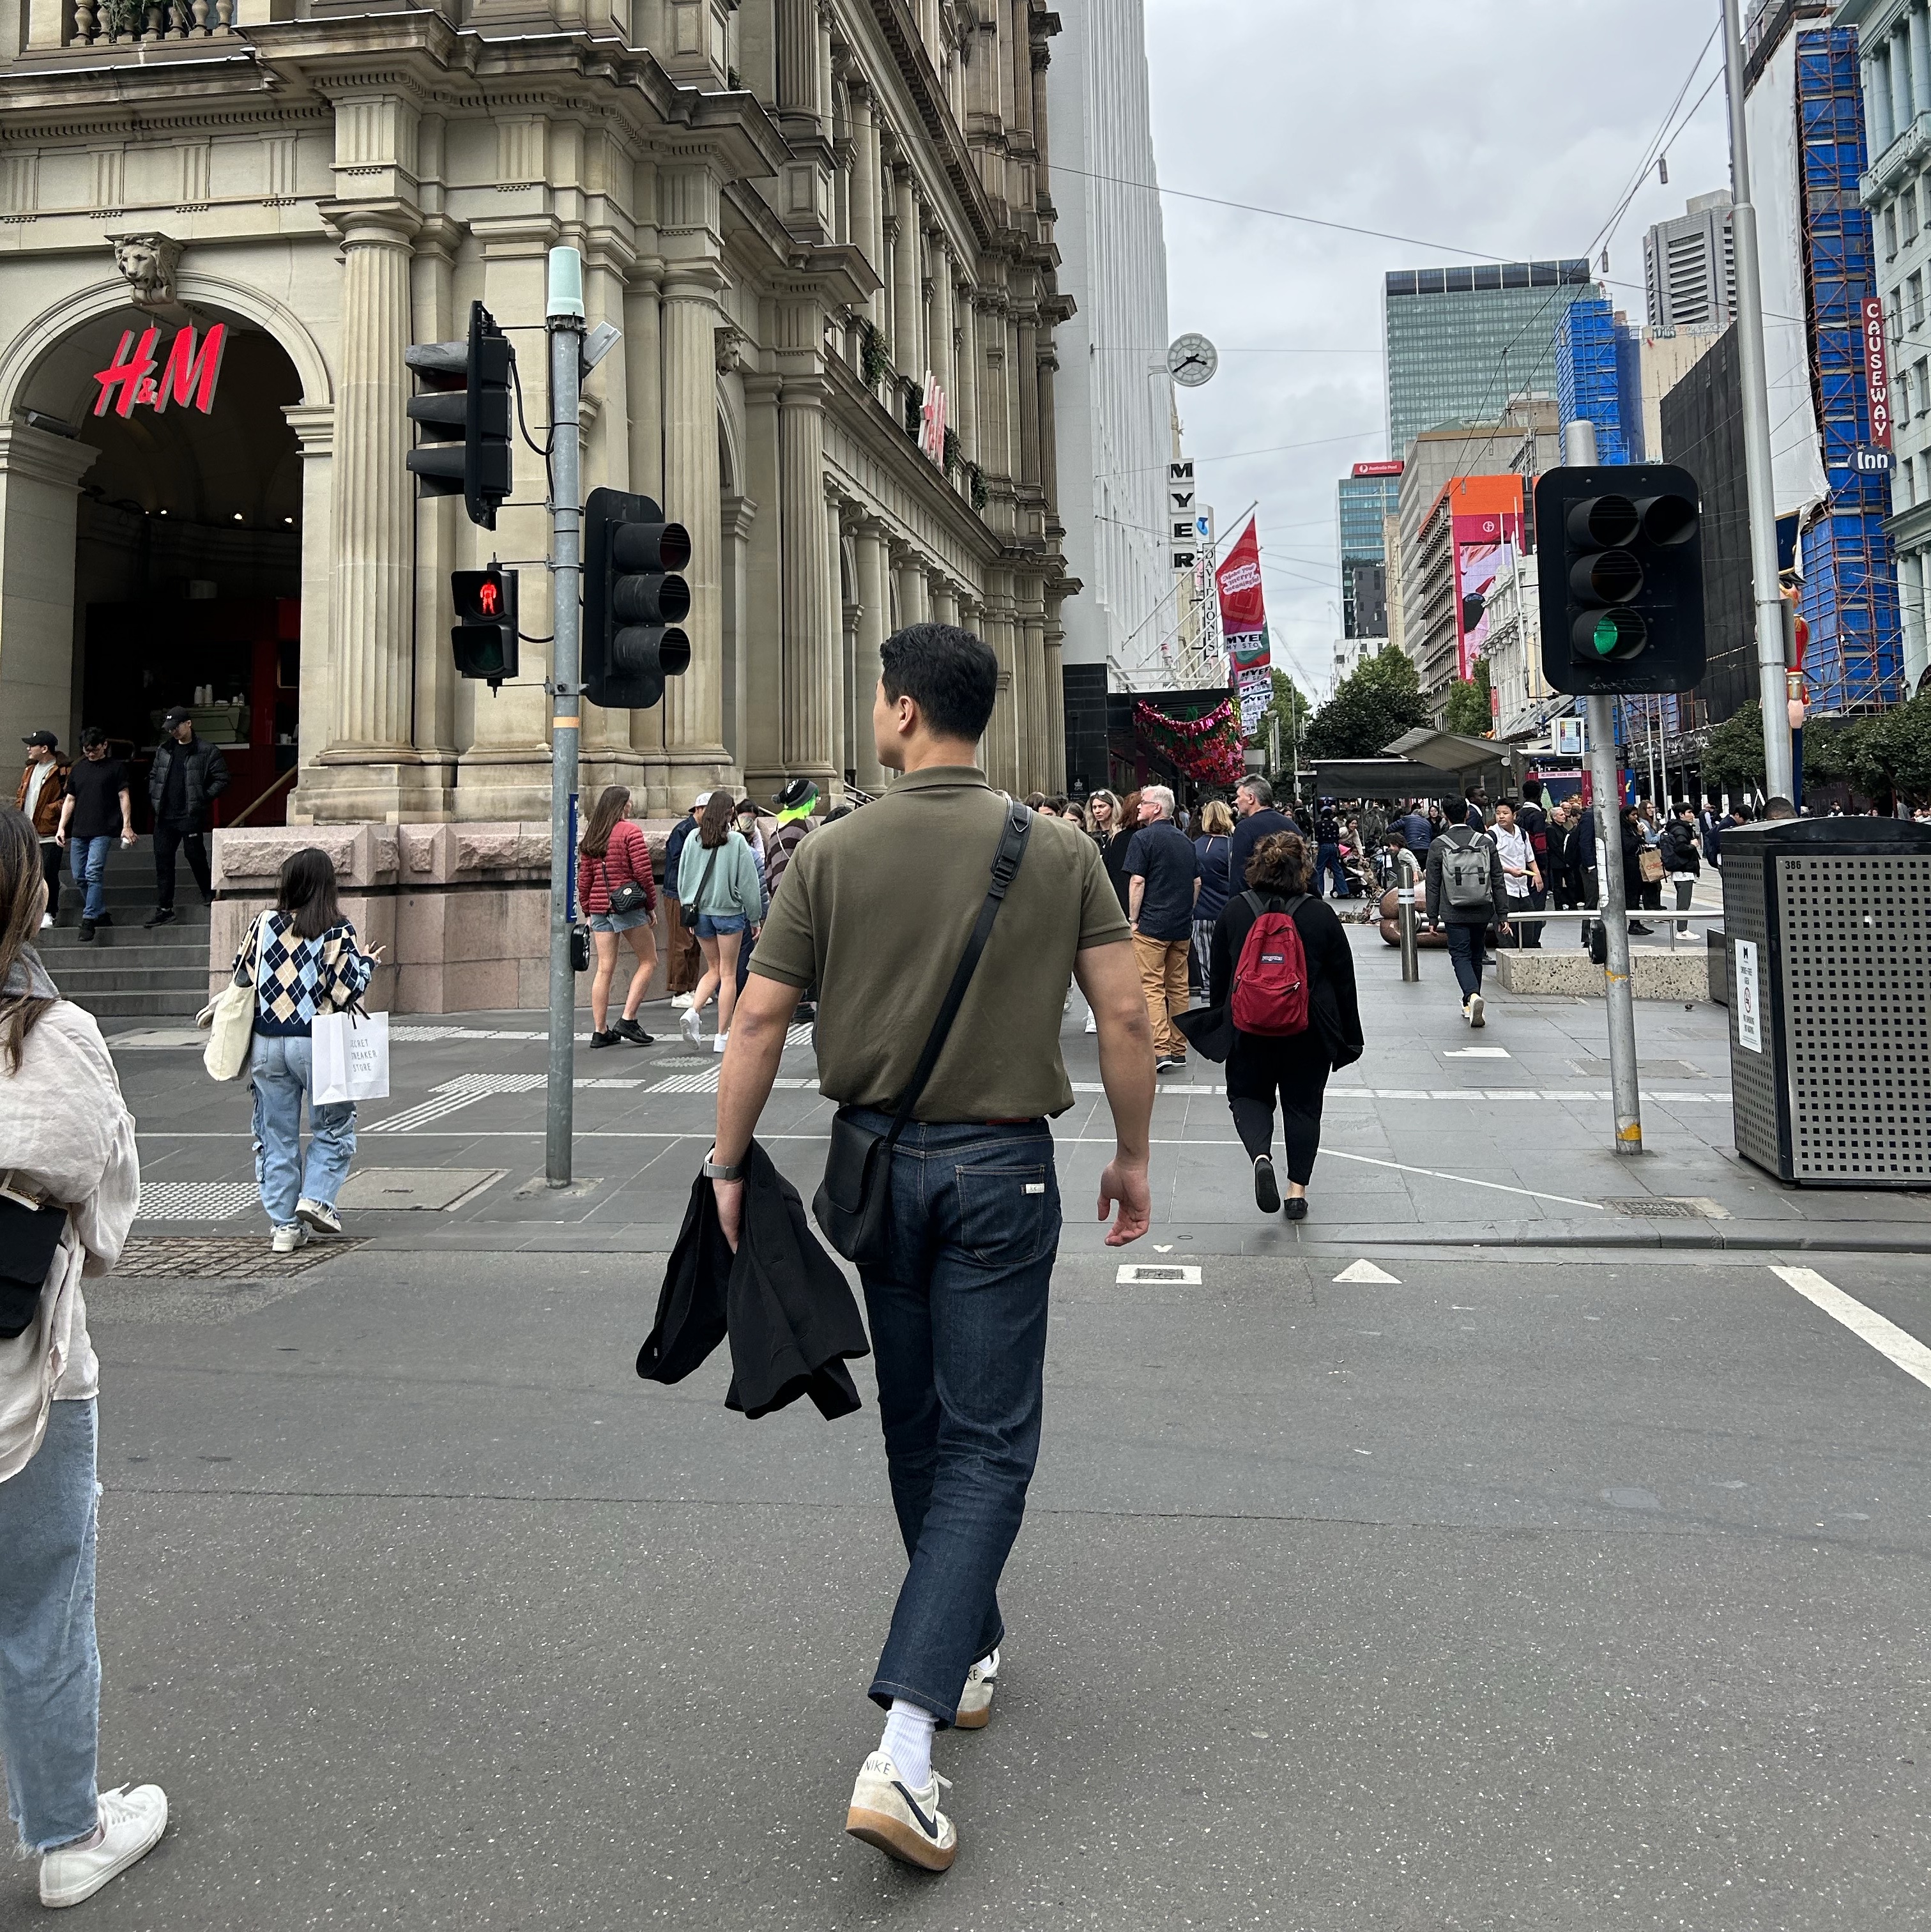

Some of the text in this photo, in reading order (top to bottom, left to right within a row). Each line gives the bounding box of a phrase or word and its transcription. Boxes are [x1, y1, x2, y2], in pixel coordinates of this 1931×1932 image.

[93, 323, 227, 419] H&M
[1866, 303, 1887, 437] CAUSEWAY
[1857, 452, 1889, 470] Inn
[1170, 462, 1195, 568] MYER
[1785, 860, 1801, 870] 386
[353, 1062, 372, 1072] STORE
[968, 1669, 978, 1681] KE
[864, 1759, 891, 1775] NIKE
